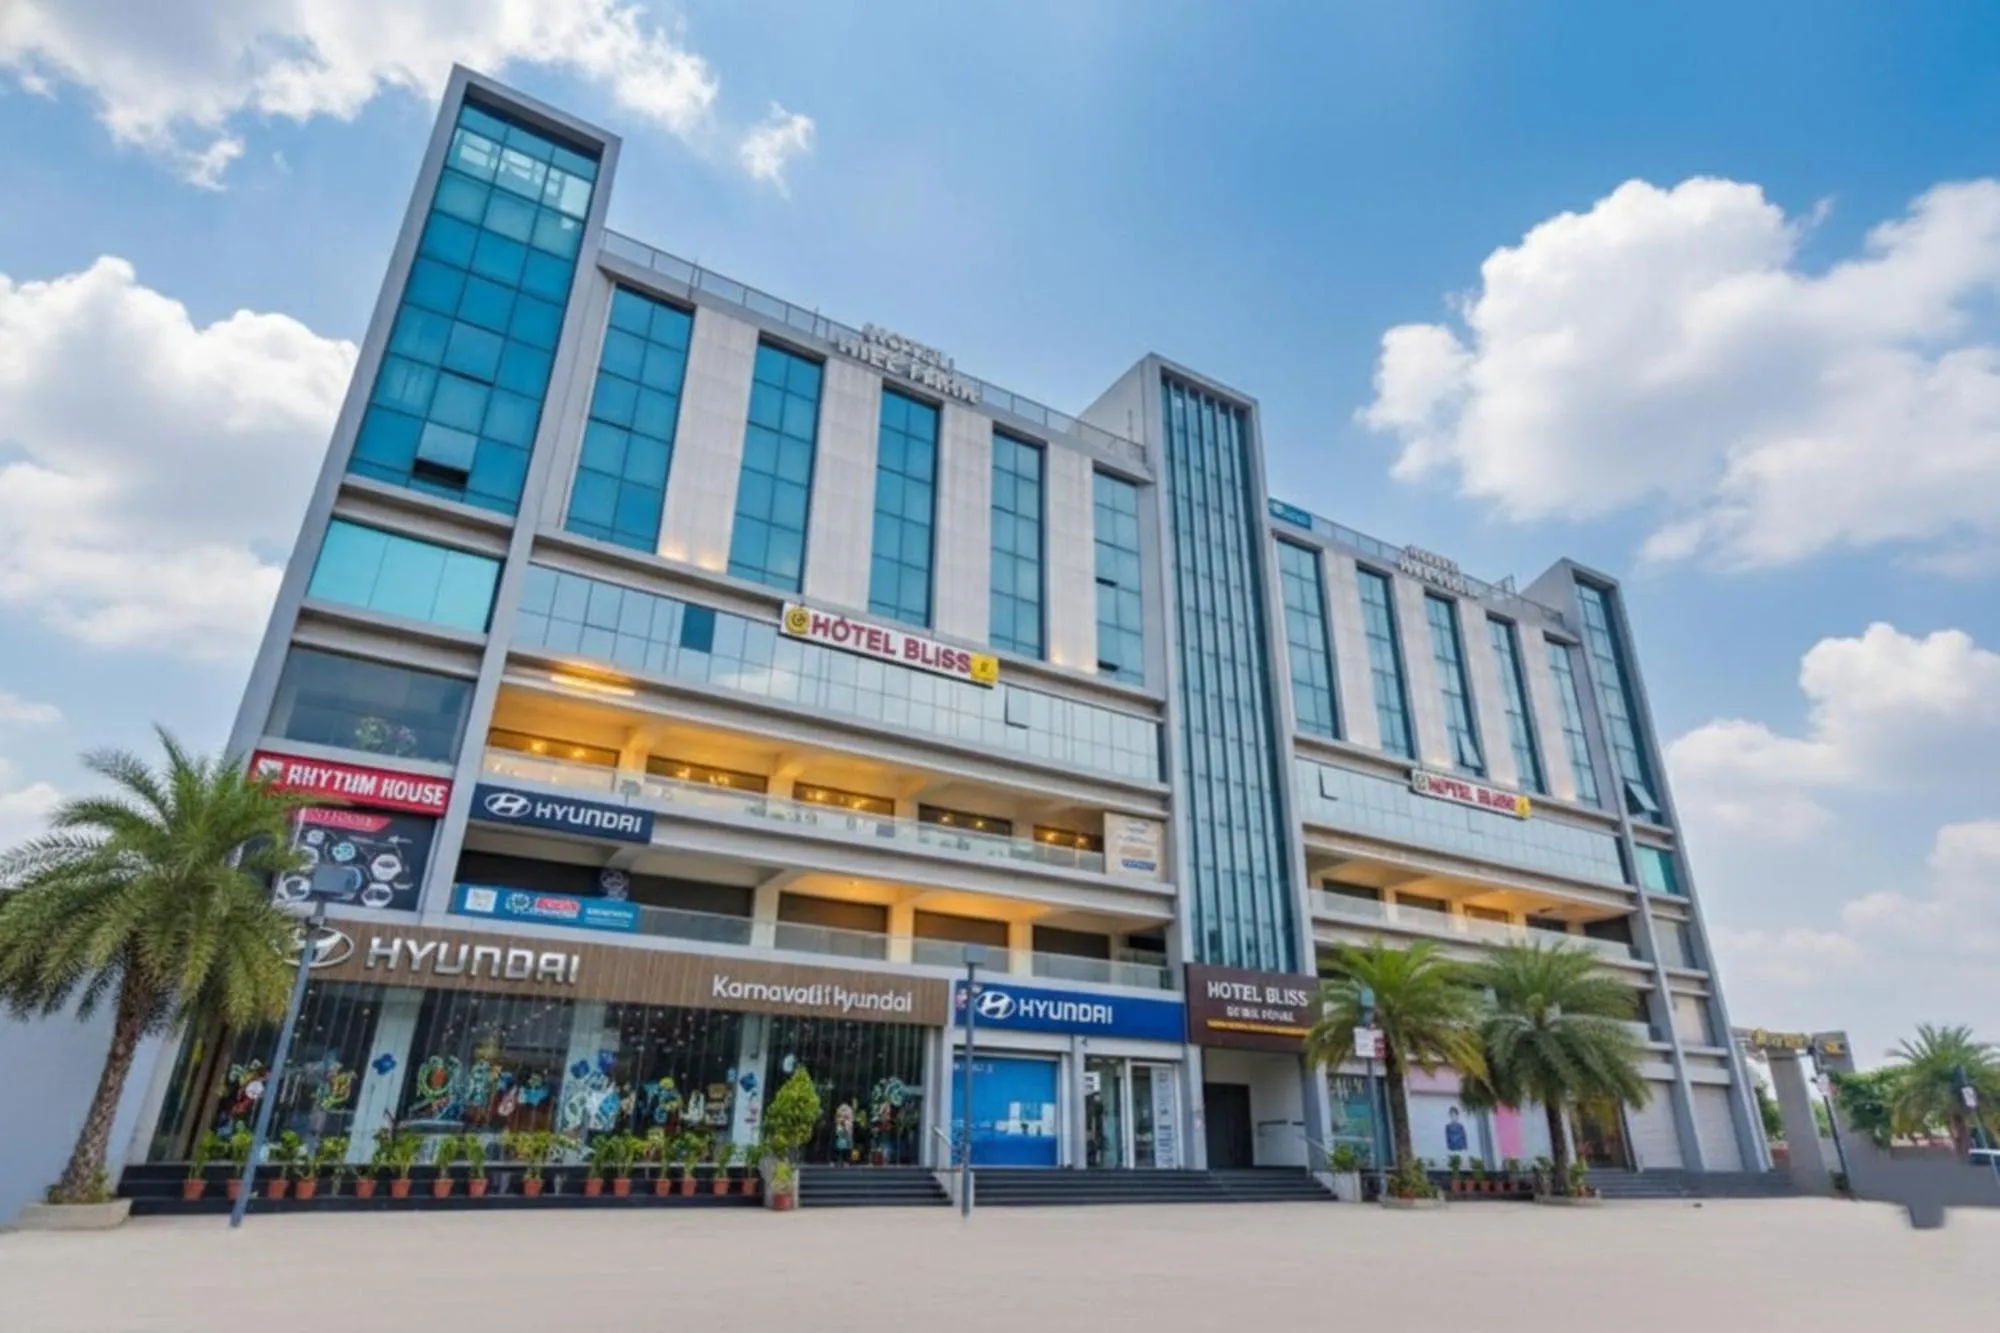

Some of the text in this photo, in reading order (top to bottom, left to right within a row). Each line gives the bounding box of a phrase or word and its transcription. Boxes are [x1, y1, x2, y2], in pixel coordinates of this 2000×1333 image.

[812, 613, 970, 673] HOTEL BLISS
[380, 777, 447, 806] HOUSE
[535, 801, 642, 833] HYUNDAI
[367, 936, 580, 984] HYUNDAI
[1207, 980, 1308, 1006] HOTEL BLISS
[1019, 998, 1113, 1024] HYUNDAI
